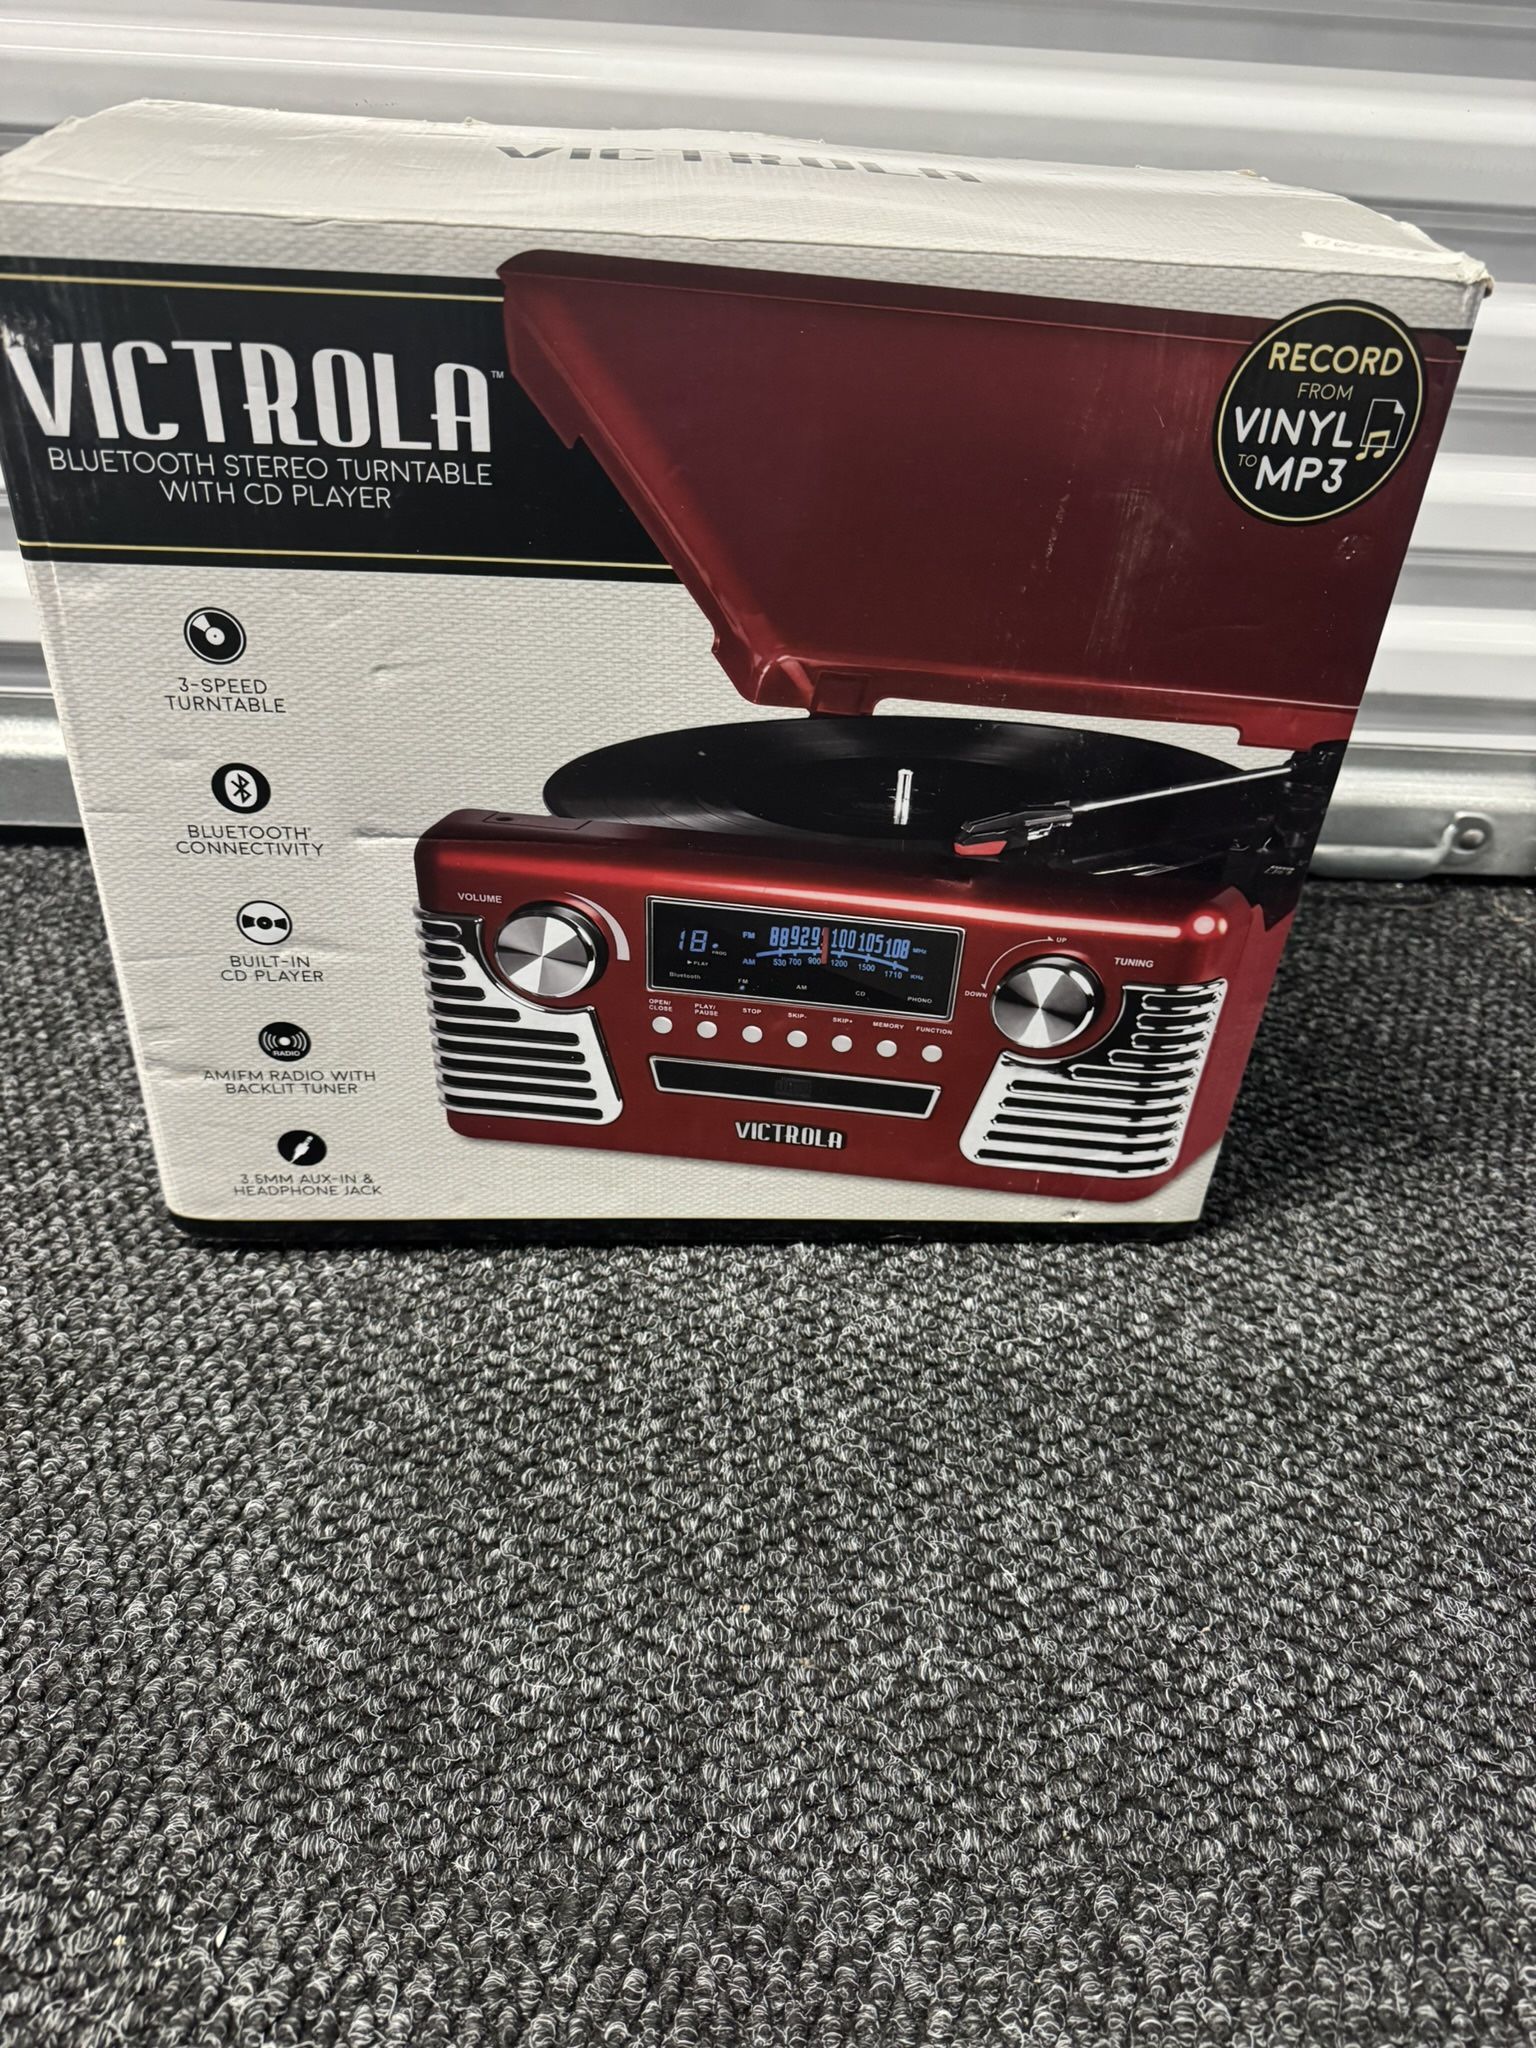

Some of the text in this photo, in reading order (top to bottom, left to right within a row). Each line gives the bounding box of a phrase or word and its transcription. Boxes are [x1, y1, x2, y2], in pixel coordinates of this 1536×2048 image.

[496, 145, 983, 184] VICTROLA
[1267, 341, 1404, 376] RECORD
[6, 340, 492, 453] VICTROLA
[1296, 382, 1354, 401] FROM
[1234, 405, 1353, 448] VINYL
[47, 447, 493, 486] BLUETOOTH STEREO TURNTABLE
[1238, 453, 1348, 494] TO MP3
[158, 479, 392, 509] WITH CD PLAYER
[177, 677, 268, 694] 3-SPEED
[164, 695, 287, 713] TURNTABLE
[175, 841, 324, 856] CONNECTIVITY
[457, 892, 503, 904] VOLUME
[742, 931, 756, 940] FM
[830, 928, 857, 949] 100
[857, 932, 885, 953] 105
[883, 938, 912, 959] 108
[1055, 936, 1068, 944] UP
[229, 955, 311, 969] BUILT-IN
[742, 958, 756, 966] AM
[773, 958, 787, 967] 530
[788, 957, 802, 966] 700
[807, 957, 822, 966] 900
[831, 959, 849, 968] 1200
[858, 963, 876, 972] 1500
[884, 970, 903, 979] 1710
[1113, 957, 1155, 969] TUNING
[220, 969, 325, 982] CD PLAYER
[669, 971, 701, 980] Bluetooth
[964, 990, 988, 998] DOWN
[648, 1004, 673, 1012] CLOSE
[694, 1008, 719, 1016] PAUSE
[742, 1007, 762, 1015] STOP
[872, 1021, 905, 1030] MEMORY
[916, 1025, 953, 1035] FUNCTION
[269, 1070, 325, 1081] RADIO
[331, 1070, 377, 1081] WITH
[225, 1083, 358, 1094] BACKLIT TUNER
[735, 1121, 843, 1149] VICTROLA
[300, 1173, 357, 1184] AUX-IN
[363, 1173, 374, 1184] &
[233, 1185, 383, 1196] HEADPHONE JACK
